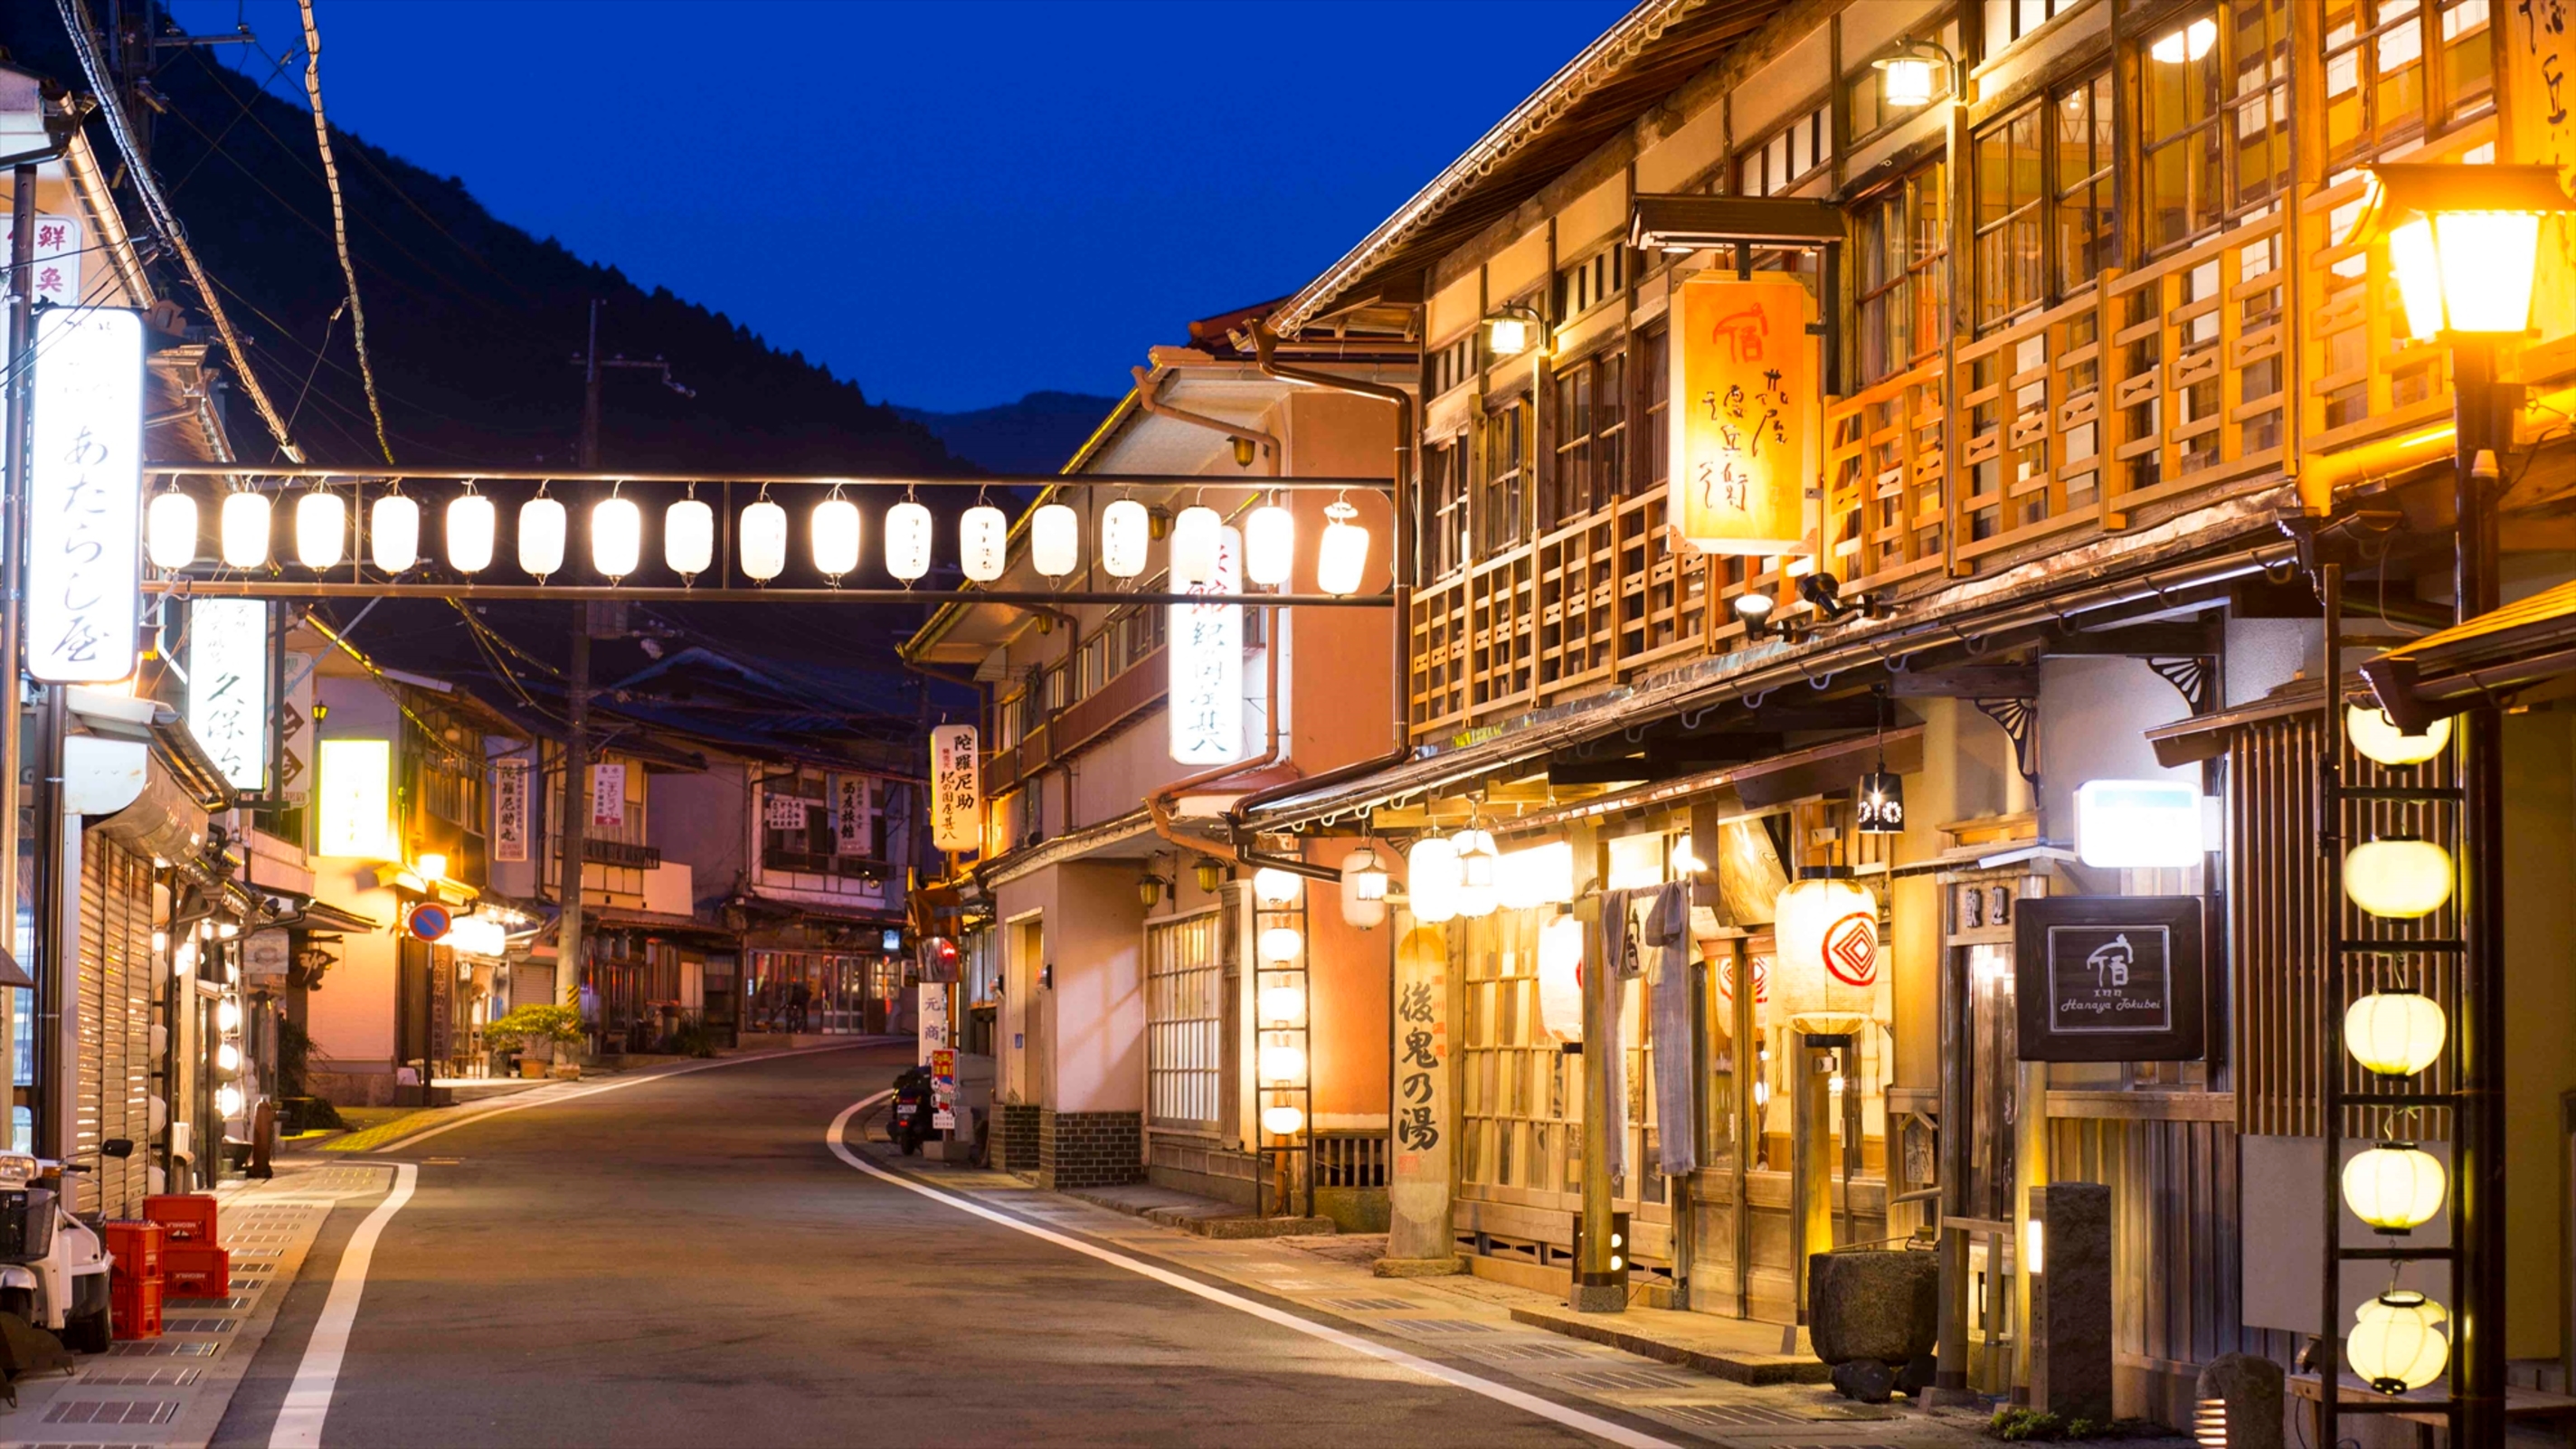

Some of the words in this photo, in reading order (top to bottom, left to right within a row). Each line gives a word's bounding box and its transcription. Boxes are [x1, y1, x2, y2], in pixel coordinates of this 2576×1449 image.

[953, 734, 974, 810] 陀羅尼助
[2086, 933, 2134, 987] 宿
[2060, 998, 2112, 1014] Hanaya
[2116, 998, 2161, 1011] Tokubei
